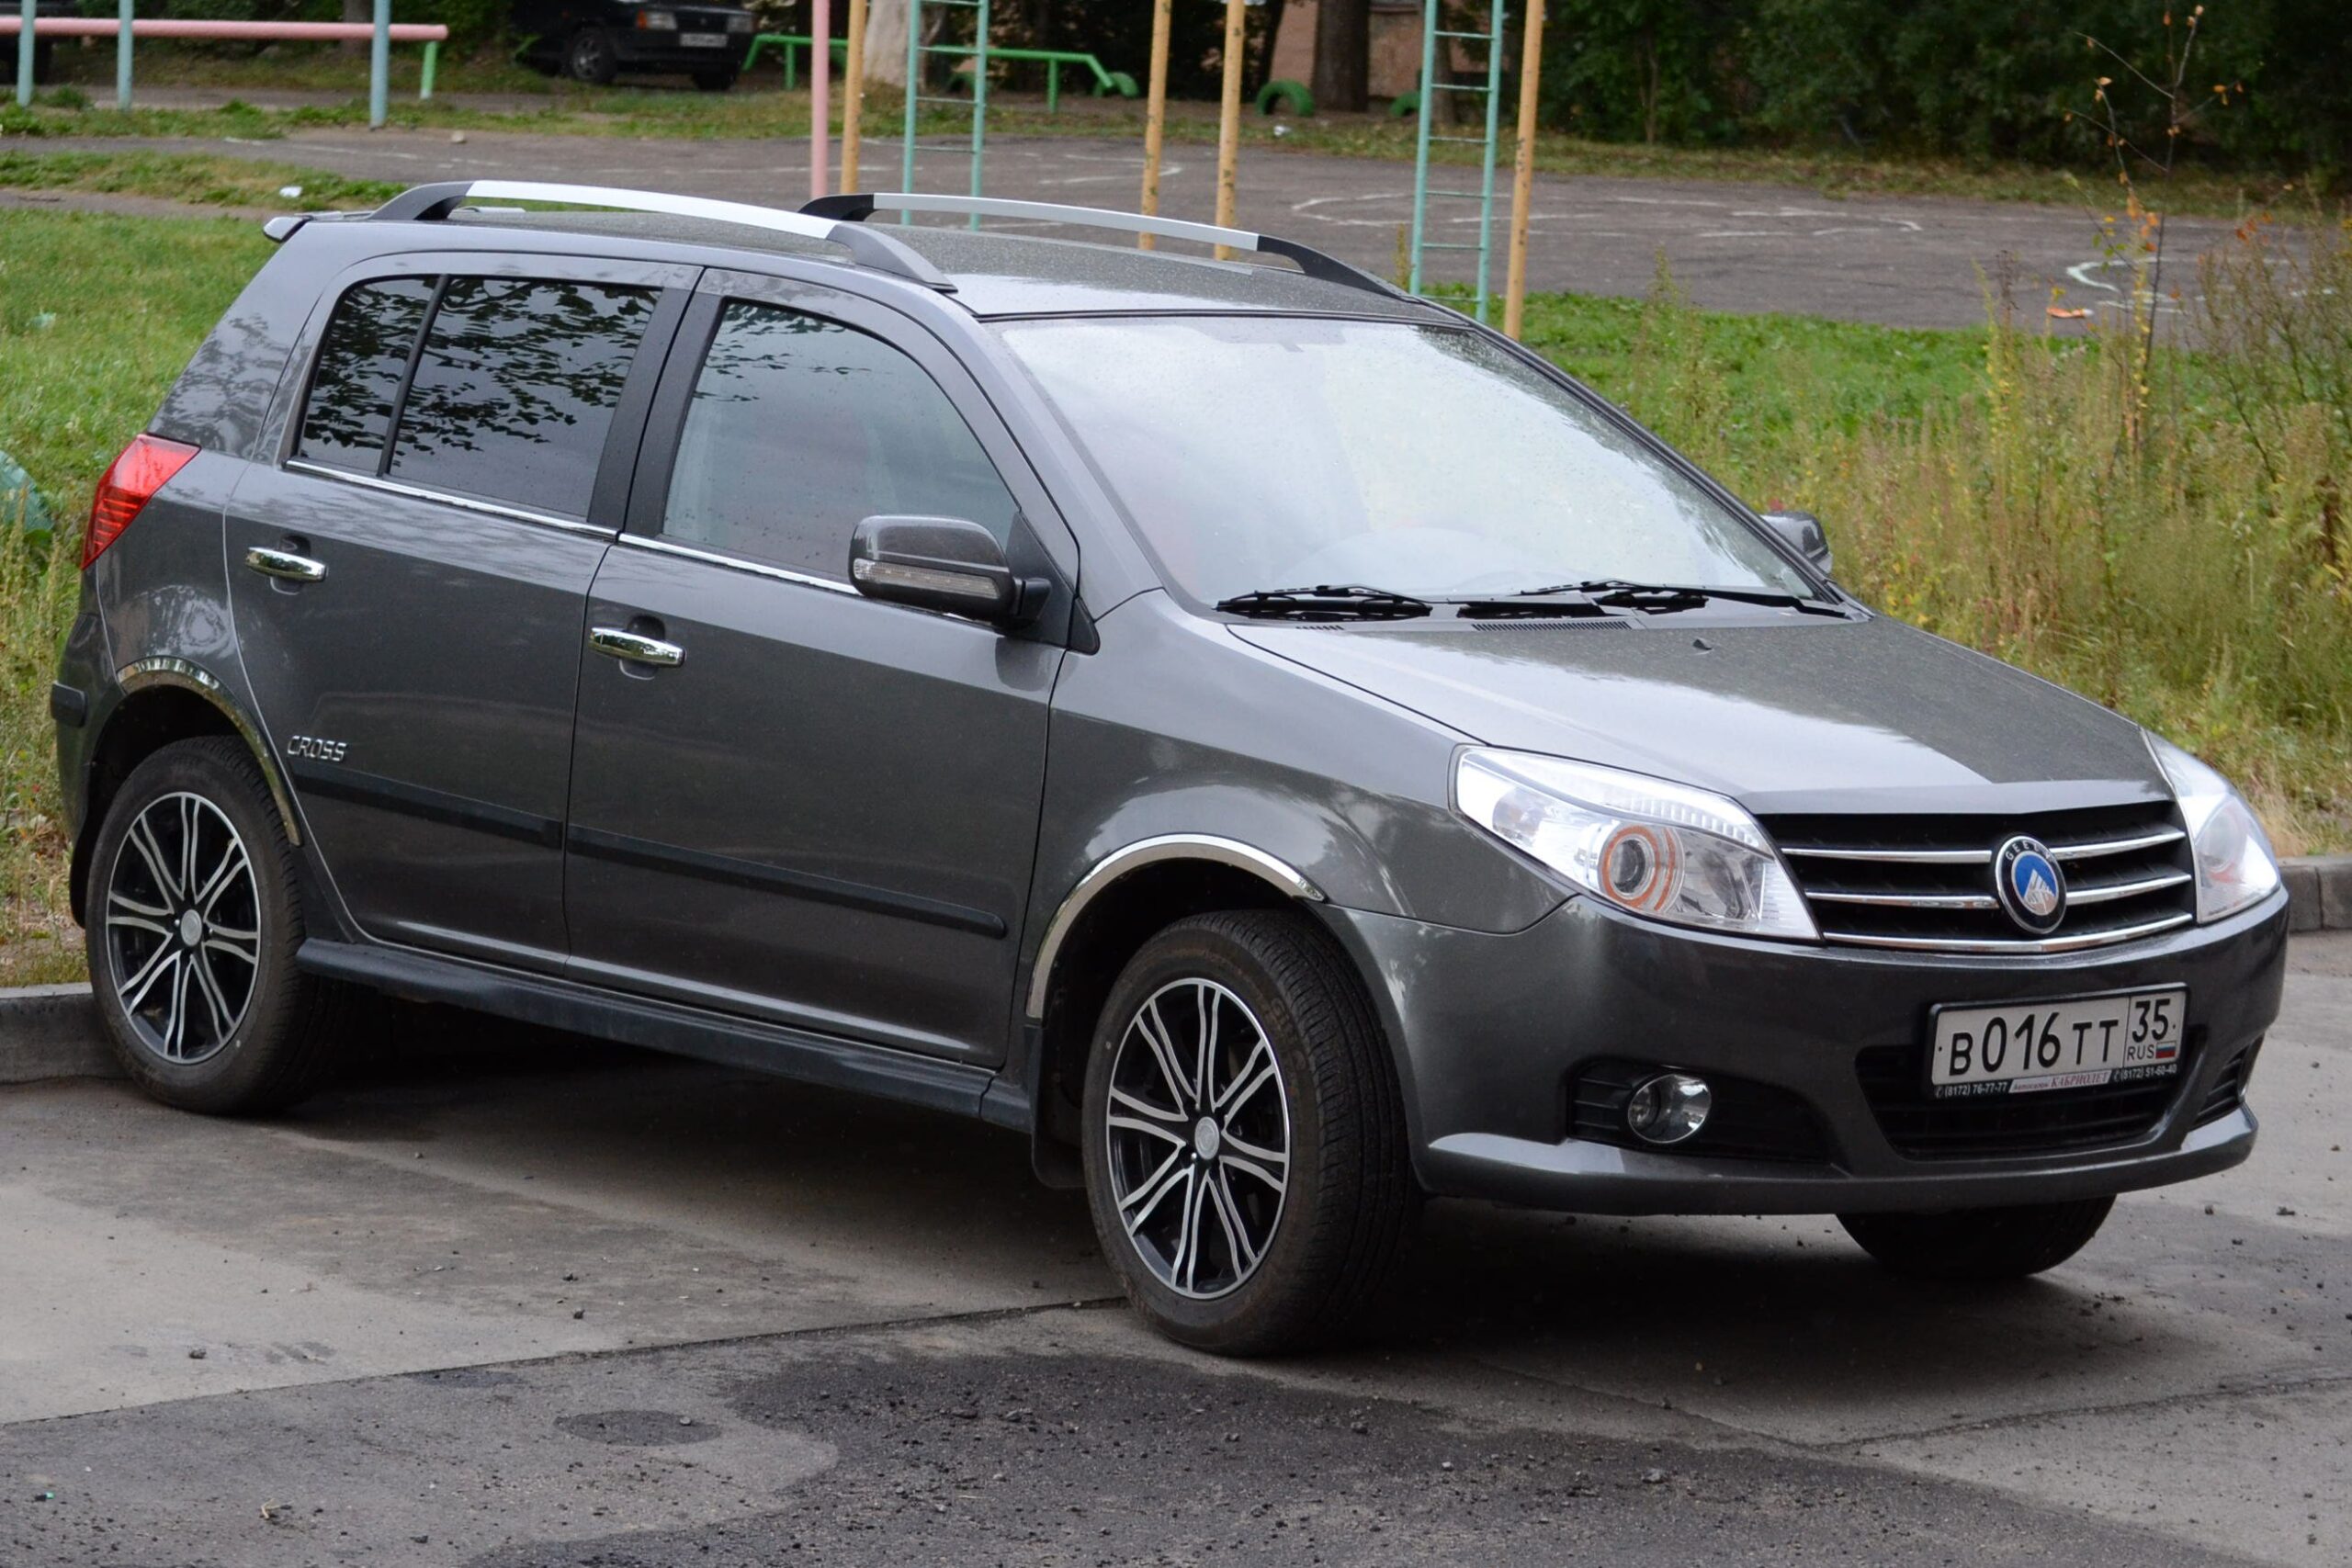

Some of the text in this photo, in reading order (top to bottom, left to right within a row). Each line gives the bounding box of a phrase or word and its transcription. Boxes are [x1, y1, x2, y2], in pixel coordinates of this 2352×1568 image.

[288, 735, 346, 761] CROSS
[2005, 840, 2052, 863] GEELY
[2132, 998, 2171, 1043] 35
[2127, 1045, 2154, 1062] RUS
